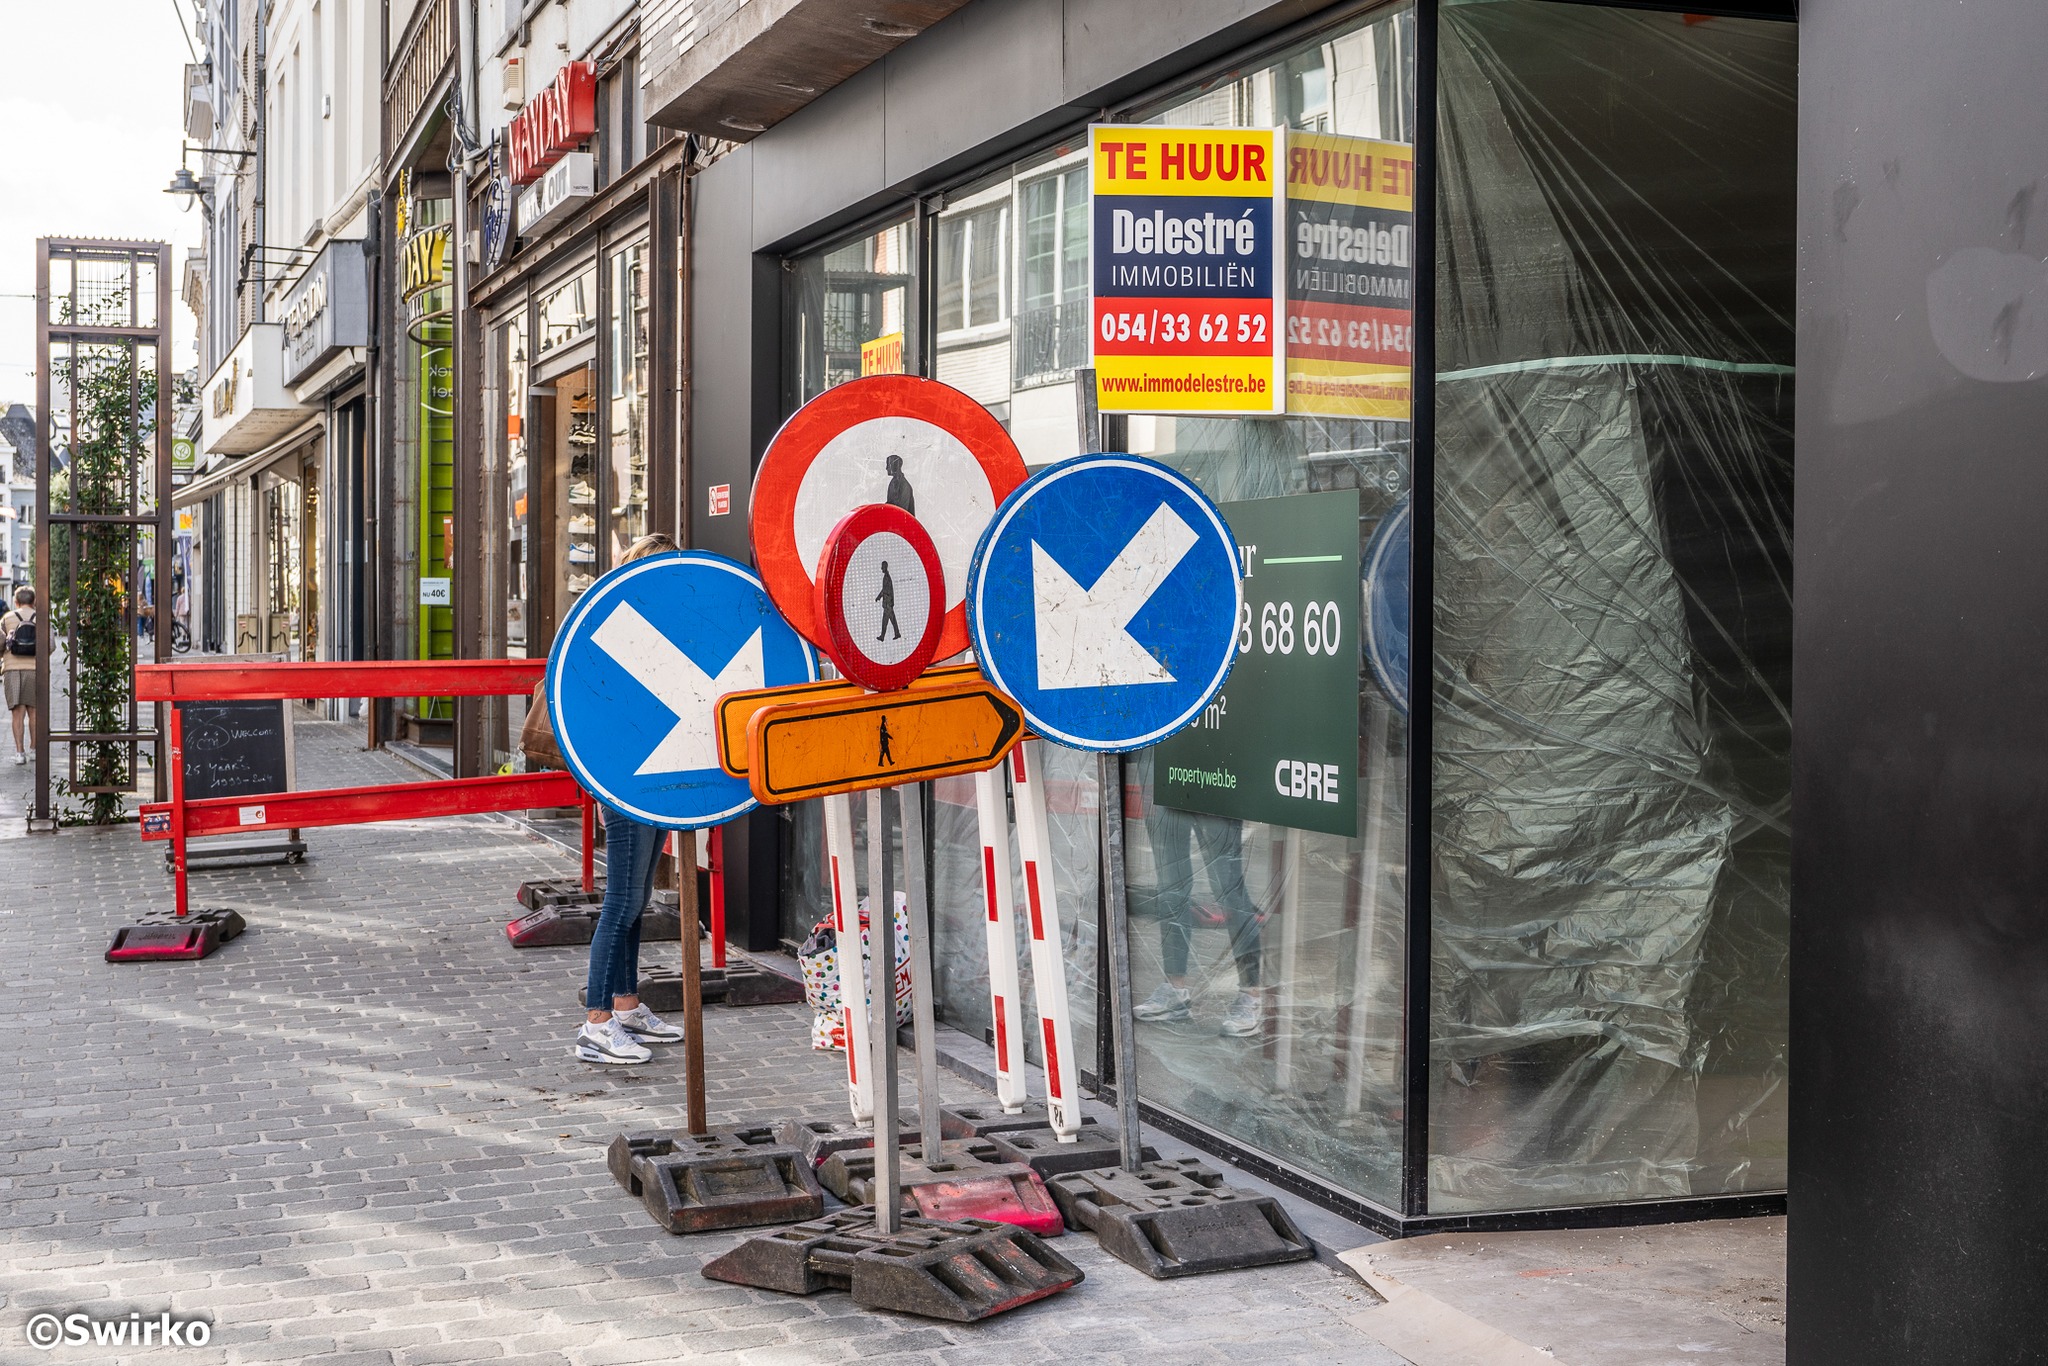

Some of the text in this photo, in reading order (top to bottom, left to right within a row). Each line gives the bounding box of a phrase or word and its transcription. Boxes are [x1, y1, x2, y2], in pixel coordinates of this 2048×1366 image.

[508, 60, 572, 182] MAYDAY
[1101, 143, 1267, 181] TE HUUR
[1113, 209, 1255, 255] Delestré
[1112, 262, 1255, 288] IMMOBILIËN
[1101, 309, 1267, 345] 054/33 62 52
[863, 341, 901, 376] TE HUUR
[1102, 374, 1266, 394] www.immodelestre.be
[431, 589, 446, 598] 40€
[1261, 601, 1294, 655] 68
[1304, 600, 1341, 656] 60
[186, 763, 201, 776] 25
[1169, 759, 1339, 804] propertyweb.be CBRE
